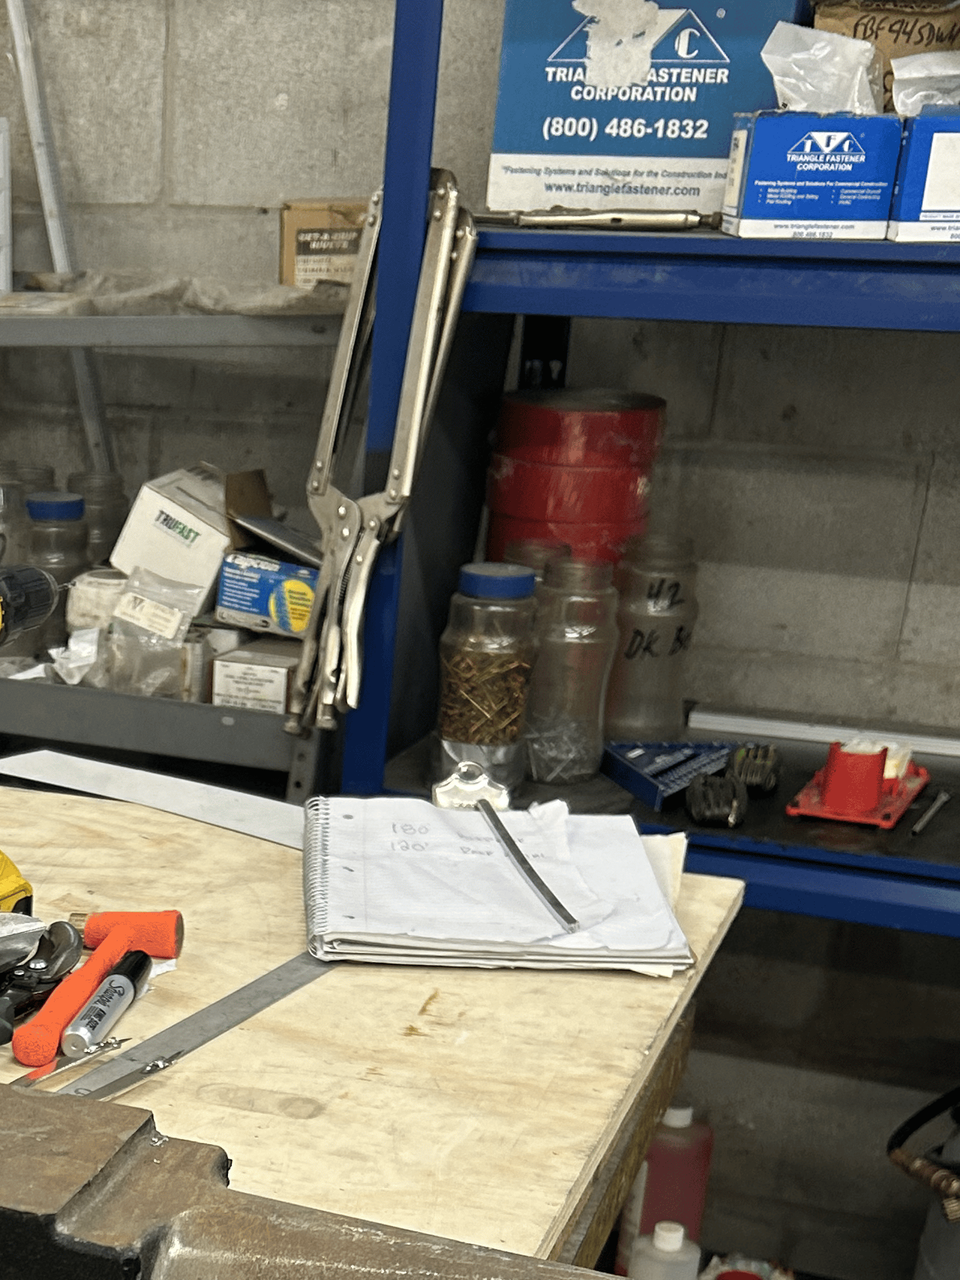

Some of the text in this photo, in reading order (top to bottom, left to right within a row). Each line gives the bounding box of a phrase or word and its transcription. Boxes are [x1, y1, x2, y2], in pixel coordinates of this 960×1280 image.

[545, 67, 729, 83] TRIA ASTENER
[571, 86, 697, 101] CORPORATION
[542, 117, 709, 141] (800) 486-1832
[787, 154, 866, 163] TRIANGLE FASTENER
[797, 163, 853, 171] CORPORATION
[544, 182, 700, 196] www.trianglefastener.com
[774, 222, 855, 231] www.trianglefastener.com
